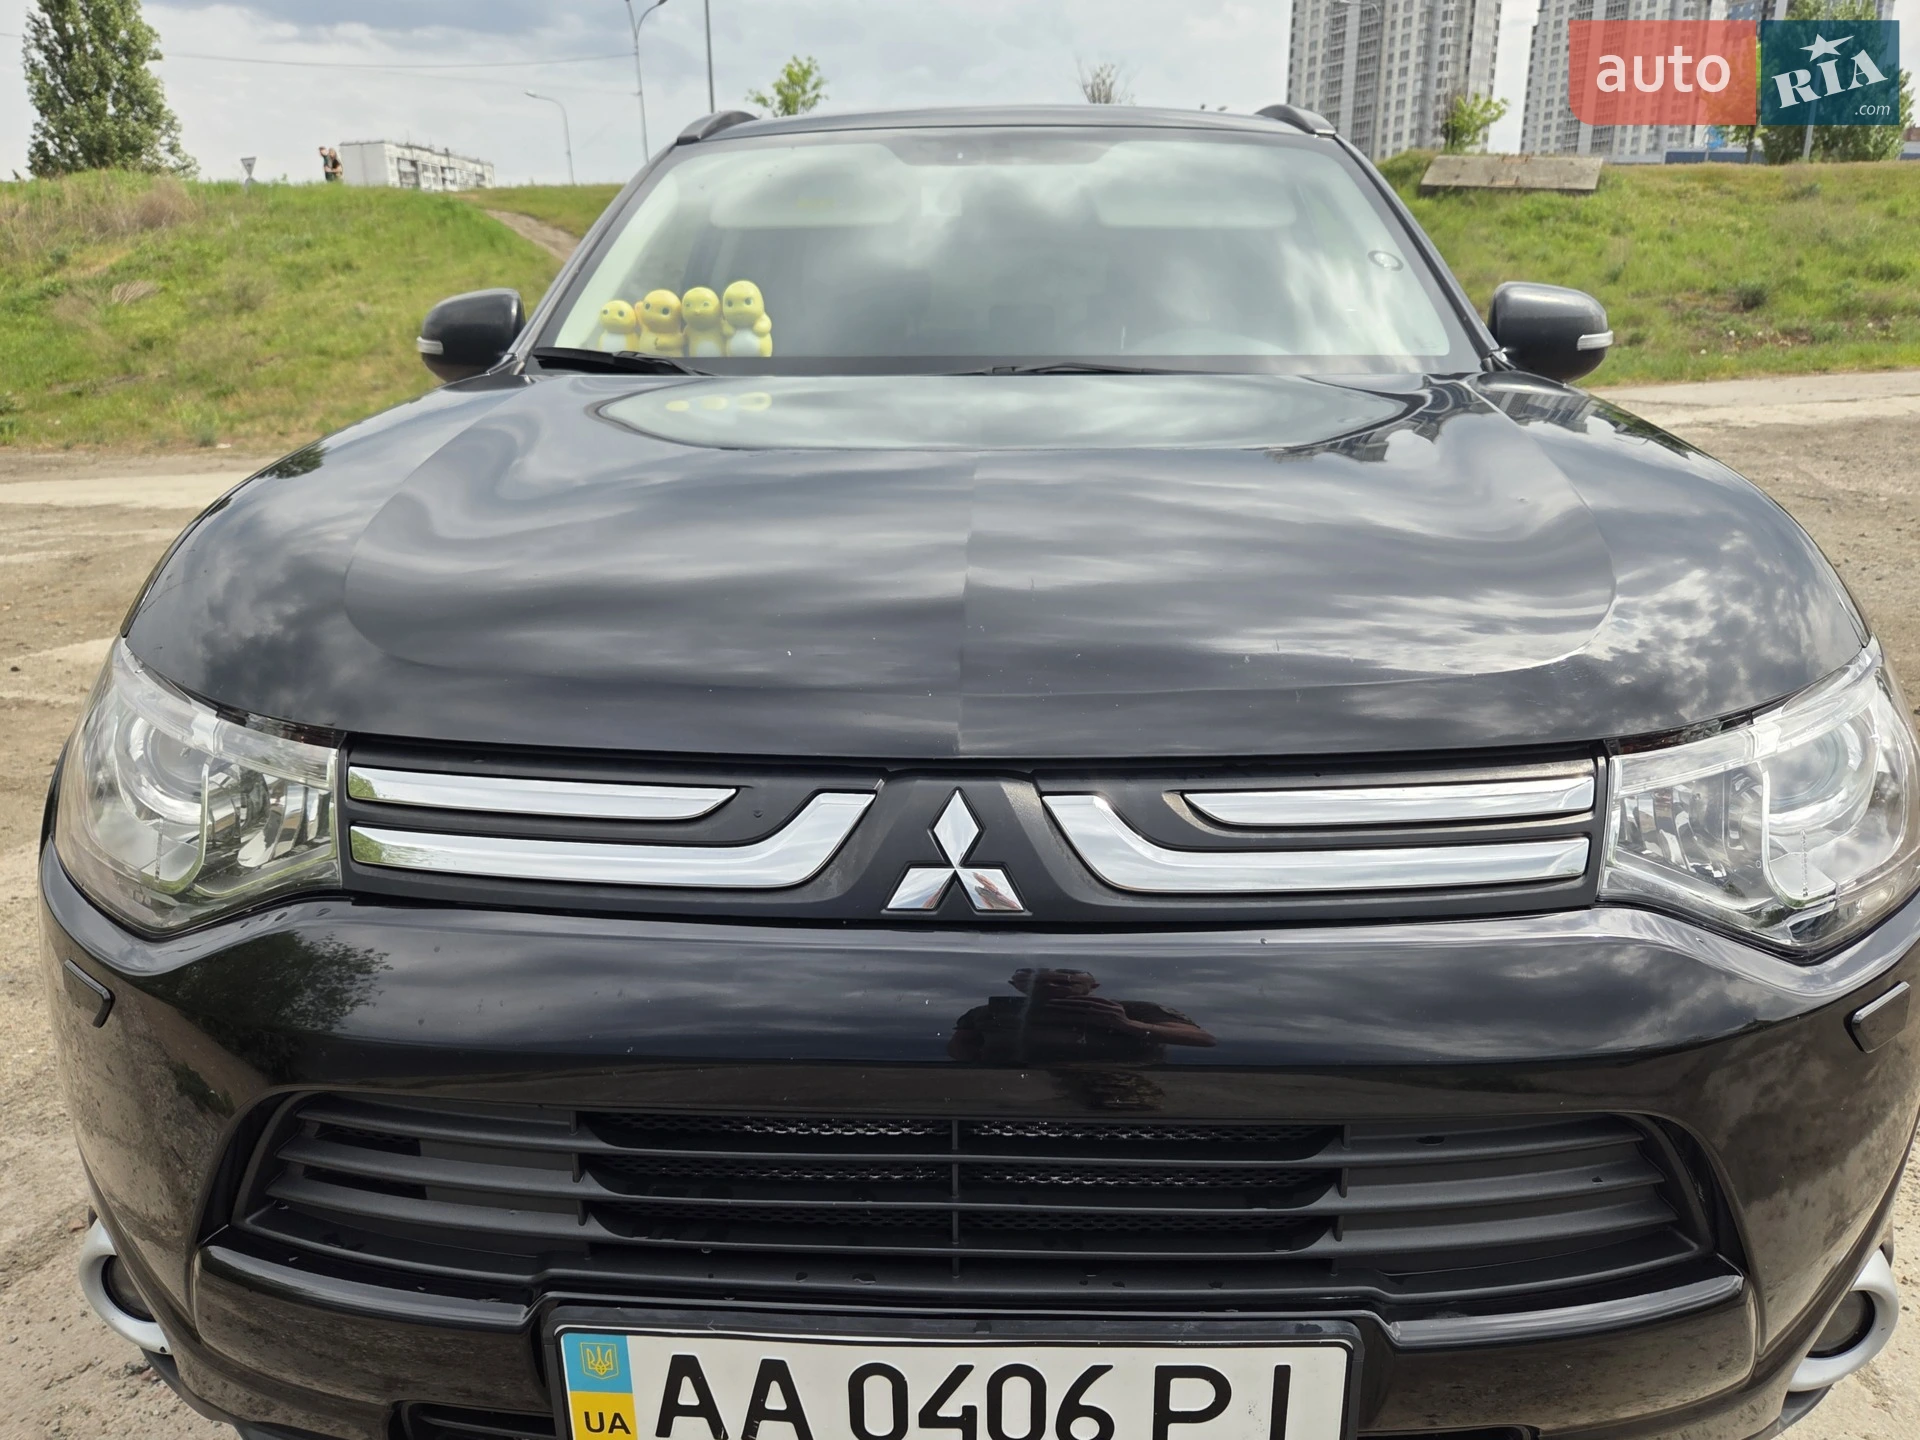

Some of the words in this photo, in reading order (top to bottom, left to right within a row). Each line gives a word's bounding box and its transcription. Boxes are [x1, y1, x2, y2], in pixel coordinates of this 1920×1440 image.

[584, 1411, 631, 1435] UA
[655, 1354, 814, 1440] AA
[848, 1362, 1115, 1440] 0406
[1152, 1364, 1291, 1440] PI
